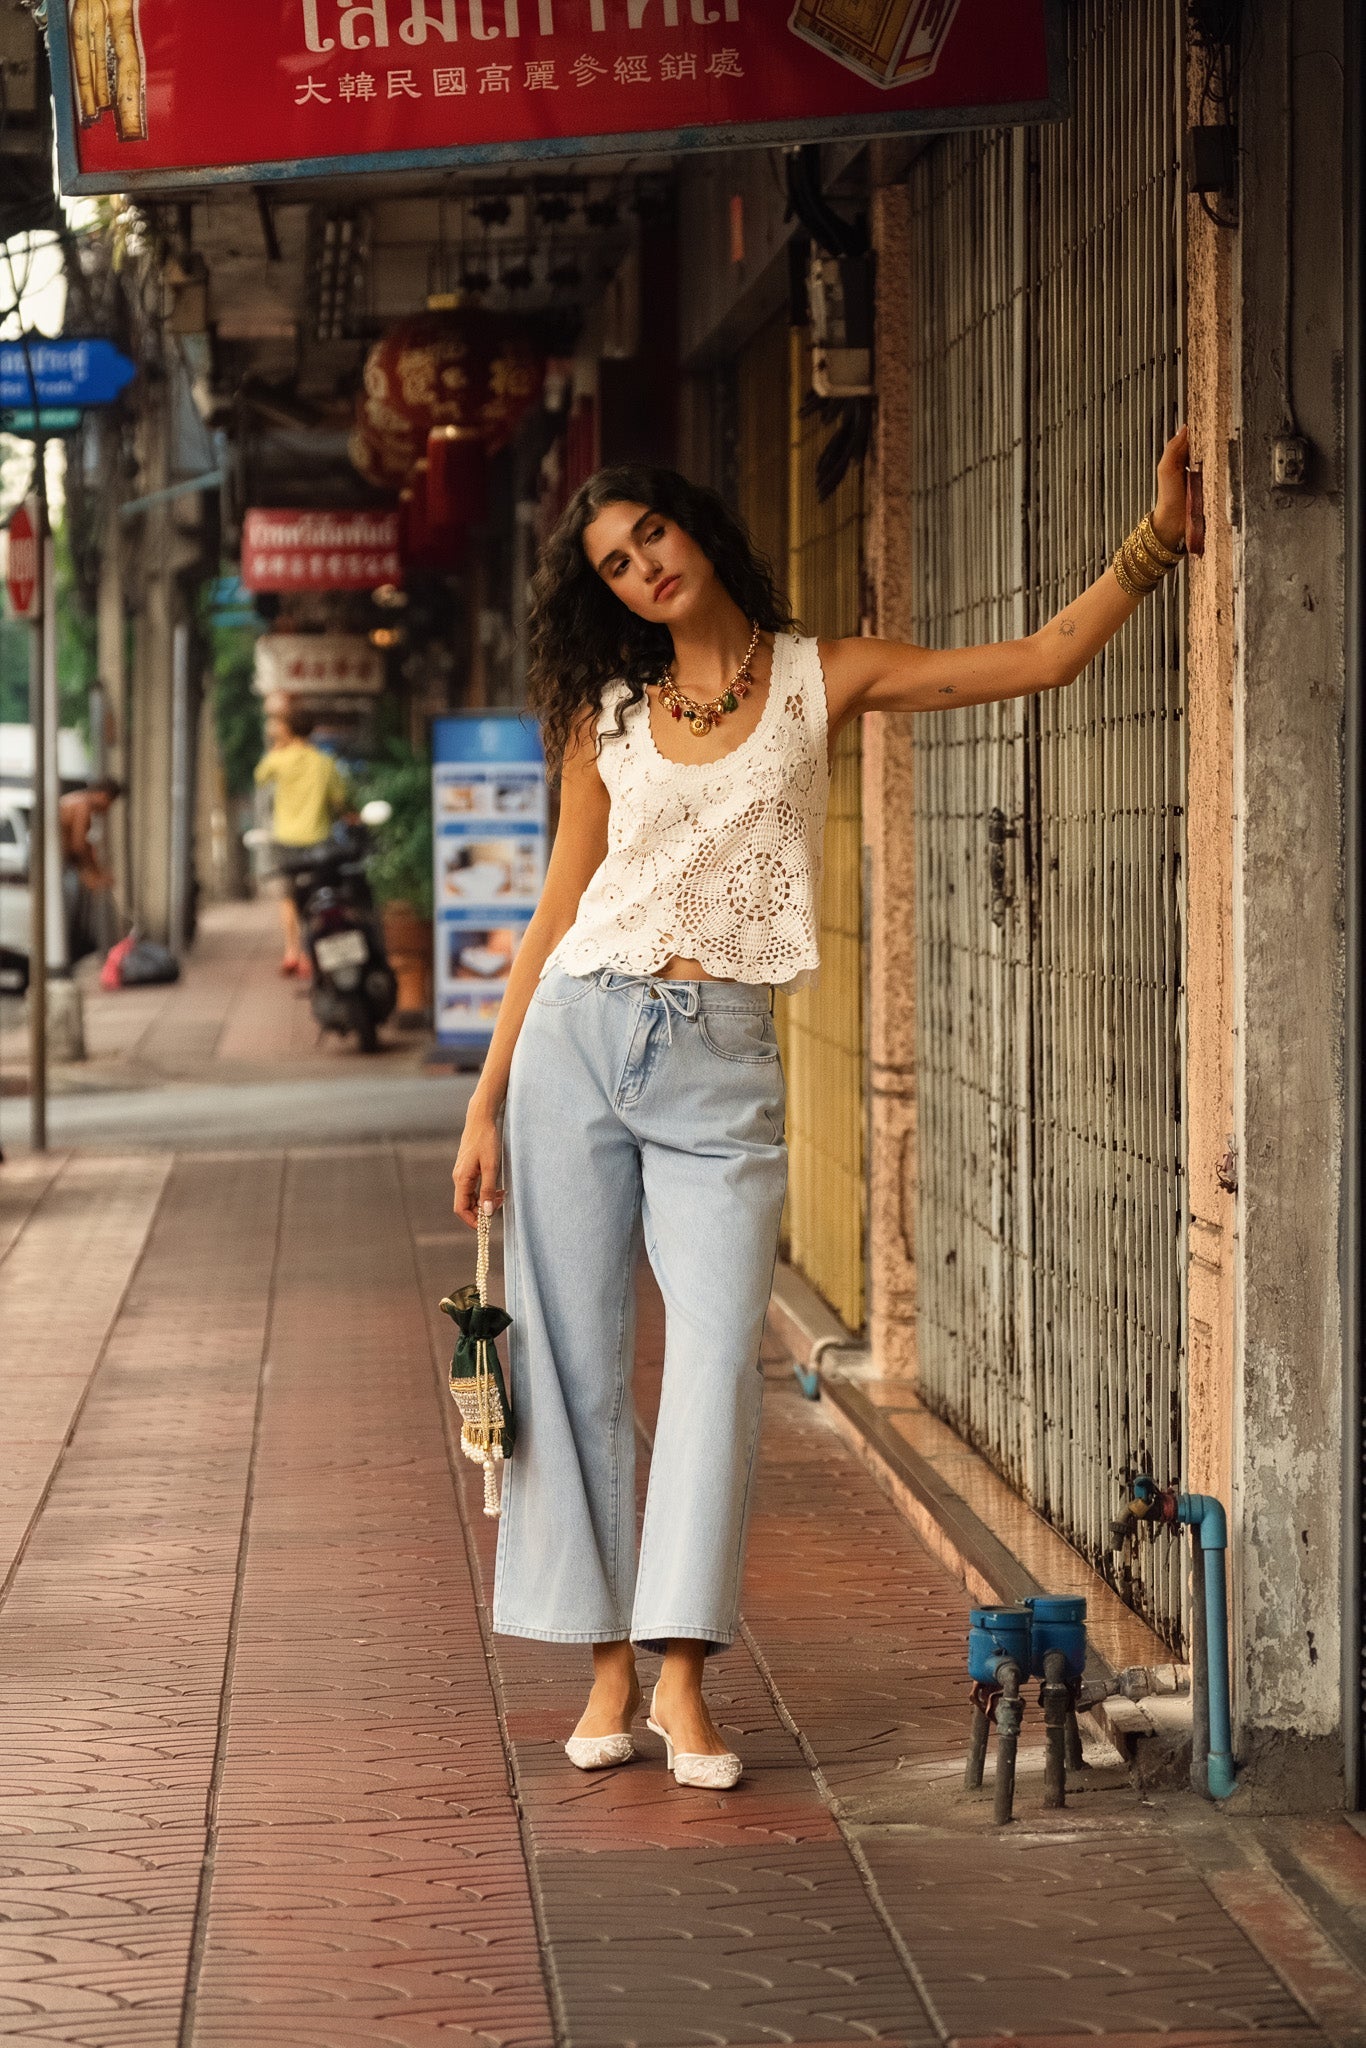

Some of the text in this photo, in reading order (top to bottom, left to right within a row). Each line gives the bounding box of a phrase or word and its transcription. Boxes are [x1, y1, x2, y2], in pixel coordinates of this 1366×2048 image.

[294, 47, 745, 105] 大韓民國高麗參經銷處
